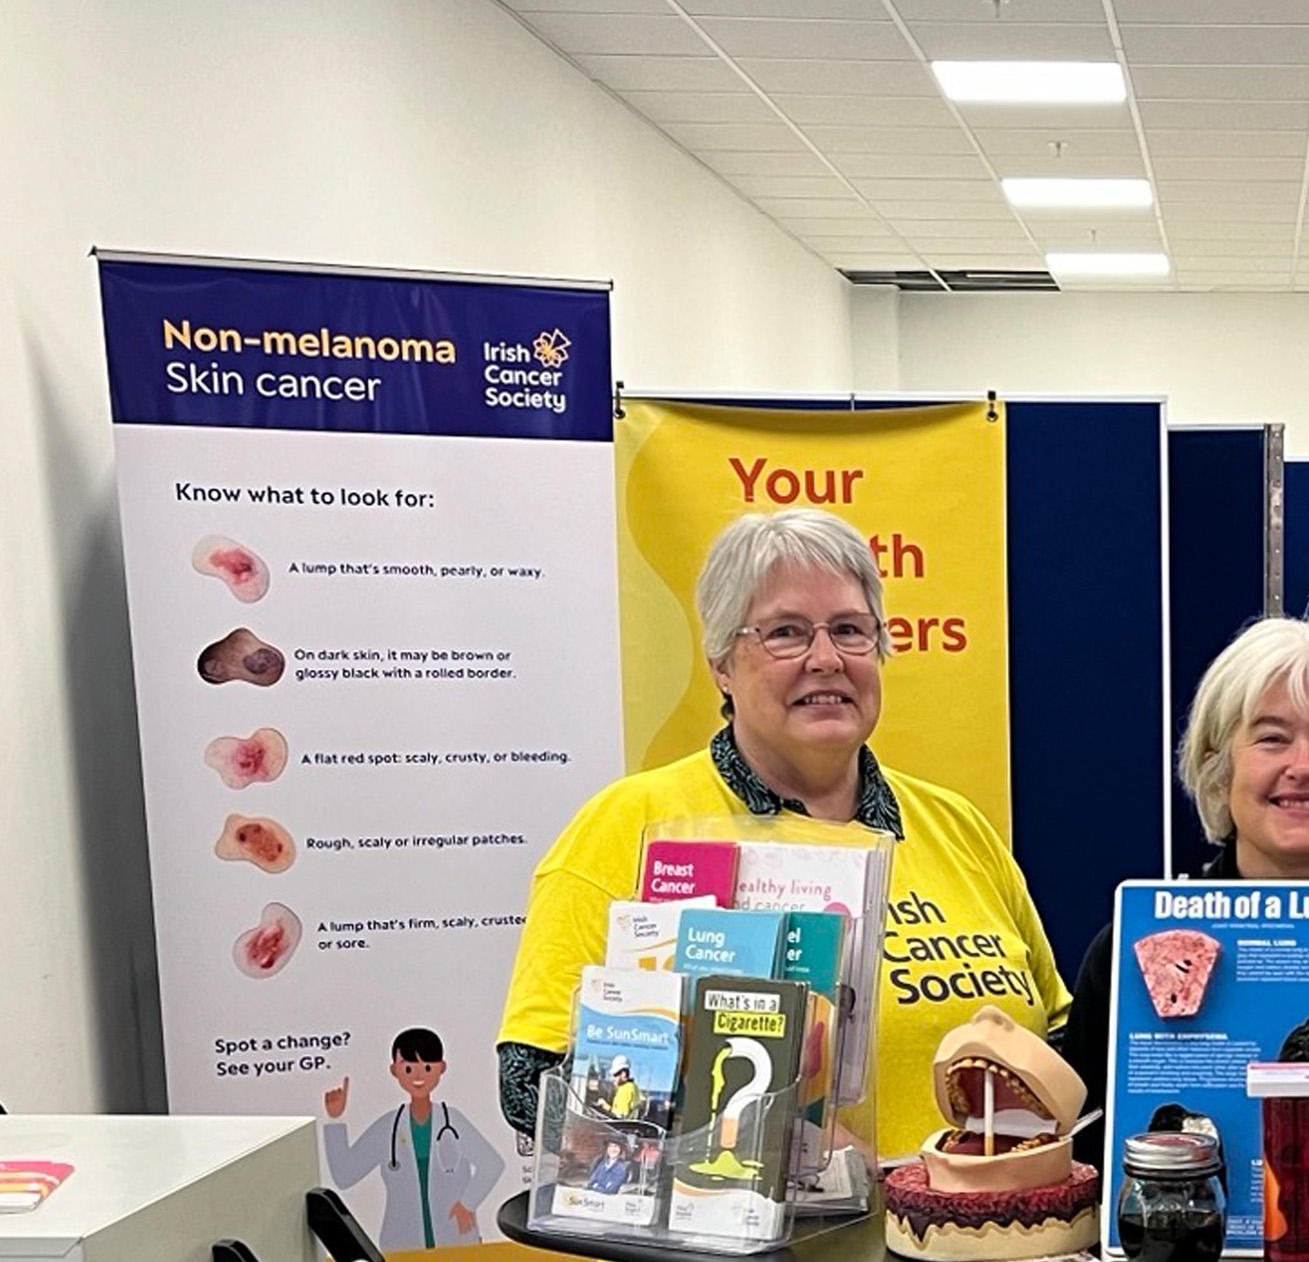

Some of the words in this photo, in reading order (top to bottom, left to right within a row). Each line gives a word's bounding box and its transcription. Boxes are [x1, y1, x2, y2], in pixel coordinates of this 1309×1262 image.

[163, 319, 456, 364] Non-melanoma
[483, 342, 531, 364] Irish
[166, 362, 244, 397] Skin
[255, 369, 381, 400] cancer
[483, 365, 563, 387] Cancer
[484, 388, 566, 413] Society
[729, 457, 864, 504] Your
[175, 483, 242, 503] Know
[247, 485, 305, 505] what
[310, 488, 335, 506] to
[340, 487, 389, 507] look
[395, 489, 435, 508] for:
[289, 563, 299, 574] A
[302, 563, 337, 577] lump
[339, 563, 381, 576] that's
[382, 563, 437, 578] smooth,
[440, 564, 486, 579] pearly,
[490, 567, 505, 578] or
[508, 568, 545, 580] waxy.
[294, 649, 314, 661] On
[318, 649, 349, 661] dark
[353, 649, 384, 664] skin,
[387, 650, 398, 662] it
[401, 651, 428, 664] may
[432, 649, 450, 661] be
[453, 650, 493, 662] brown
[497, 651, 511, 662] or
[295, 667, 339, 682] glossy
[343, 667, 378, 679] black
[382, 667, 412, 680] with
[415, 670, 424, 680] a
[425, 667, 463, 680] rolled
[467, 667, 516, 680] border.
[302, 754, 312, 764] A
[314, 753, 339, 764] flat
[341, 752, 364, 764] red
[367, 753, 402, 767] spot:
[405, 752, 442, 766] scaly,
[445, 752, 490, 765] crusty,
[493, 753, 508, 763] or
[511, 751, 572, 765] bleeding.
[306, 838, 355, 852] Rough,
[359, 837, 392, 850] scaly
[395, 838, 409, 848] or
[412, 834, 469, 849] irregular
[473, 833, 528, 847] patches.
[654, 861, 694, 877] Breast
[651, 878, 695, 894] Cancer
[735, 878, 785, 899] ealthy
[791, 879, 832, 901] living
[888, 891, 946, 925] ish
[1154, 891, 1231, 919] Death
[1234, 891, 1261, 919] of
[1265, 896, 1281, 919] a
[317, 922, 328, 932] A
[331, 921, 364, 934] lump
[367, 919, 405, 931] that's
[409, 918, 440, 931] firm,
[442, 917, 478, 930] scaly,
[319, 940, 333, 949] or
[336, 939, 370, 949] sore.
[688, 928, 725, 947] Lung
[883, 931, 1007, 963] Cancer
[685, 945, 735, 962] Cancer
[890, 963, 1034, 1006] Society
[708, 992, 750, 1009] What's
[754, 995, 765, 1010] in
[770, 1000, 777, 1011] a
[587, 1024, 603, 1038] Be
[606, 1025, 668, 1043] SunSmart
[717, 1014, 784, 1034] Cigarette?
[215, 1036, 258, 1057] Spot
[262, 1038, 273, 1051] a
[277, 1032, 351, 1053] change?
[217, 1060, 250, 1077] See
[254, 1060, 295, 1078] your
[299, 1057, 332, 1072] GP.
